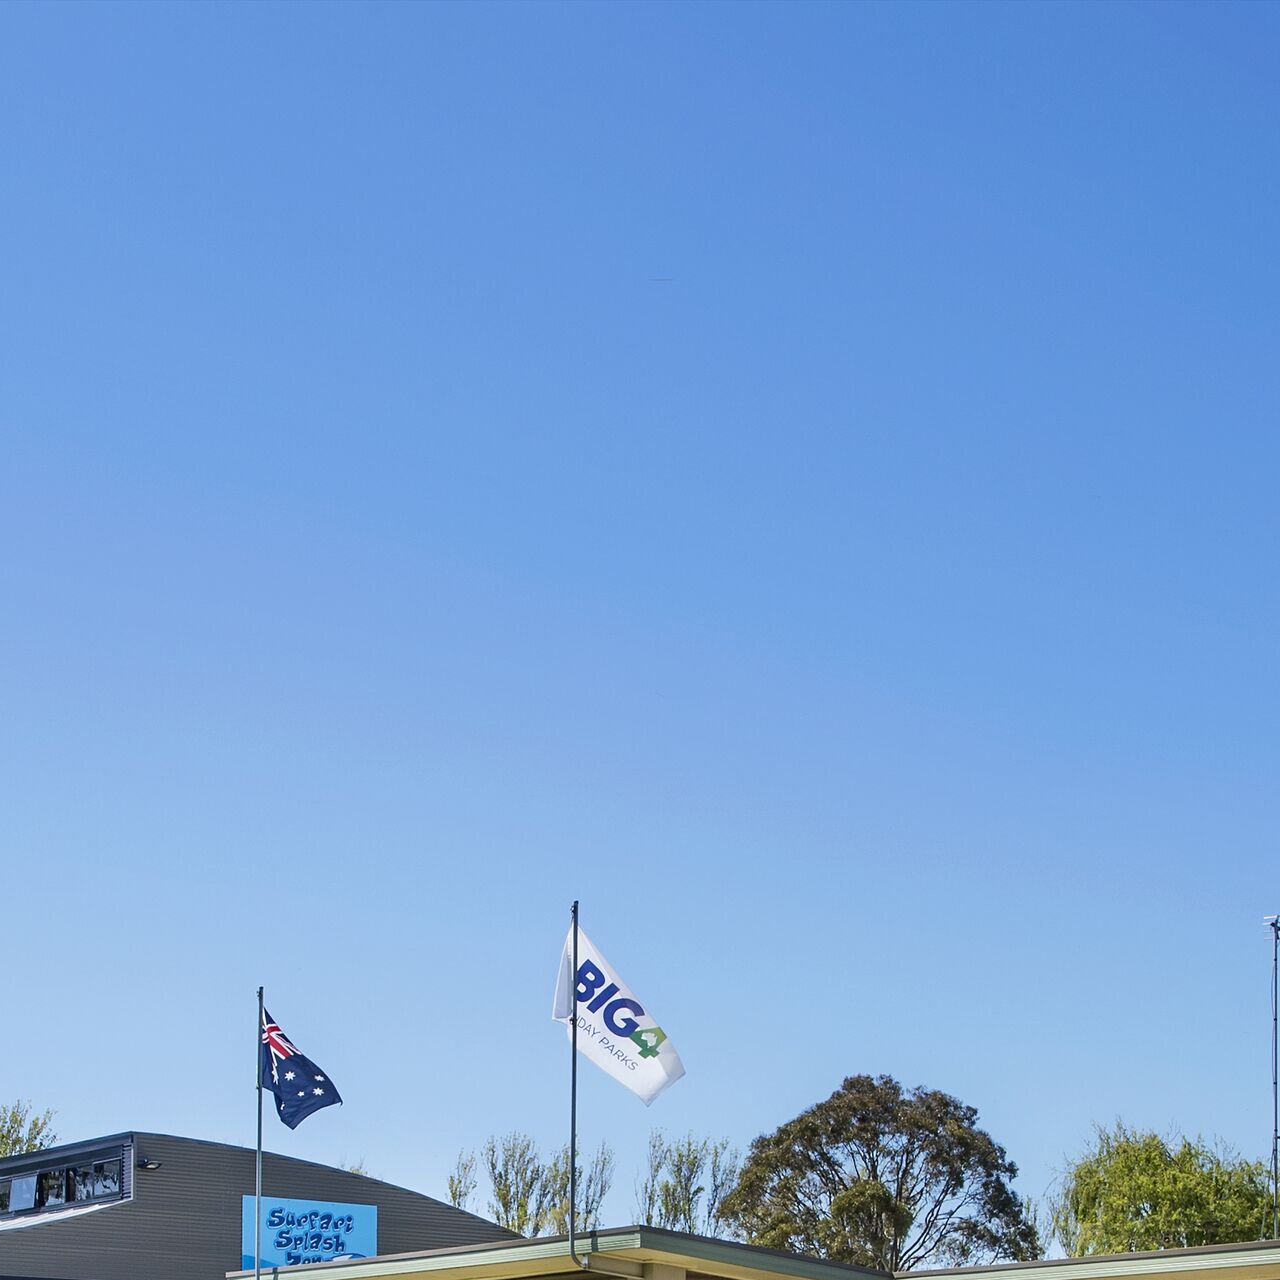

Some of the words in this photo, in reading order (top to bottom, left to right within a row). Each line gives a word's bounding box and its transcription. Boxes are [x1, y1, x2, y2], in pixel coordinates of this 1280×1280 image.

[598, 1036, 639, 1071] PARKS
[268, 1208, 353, 1233] Surfari
[275, 1230, 345, 1253] Splash
[287, 1251, 332, 1266] Zon
